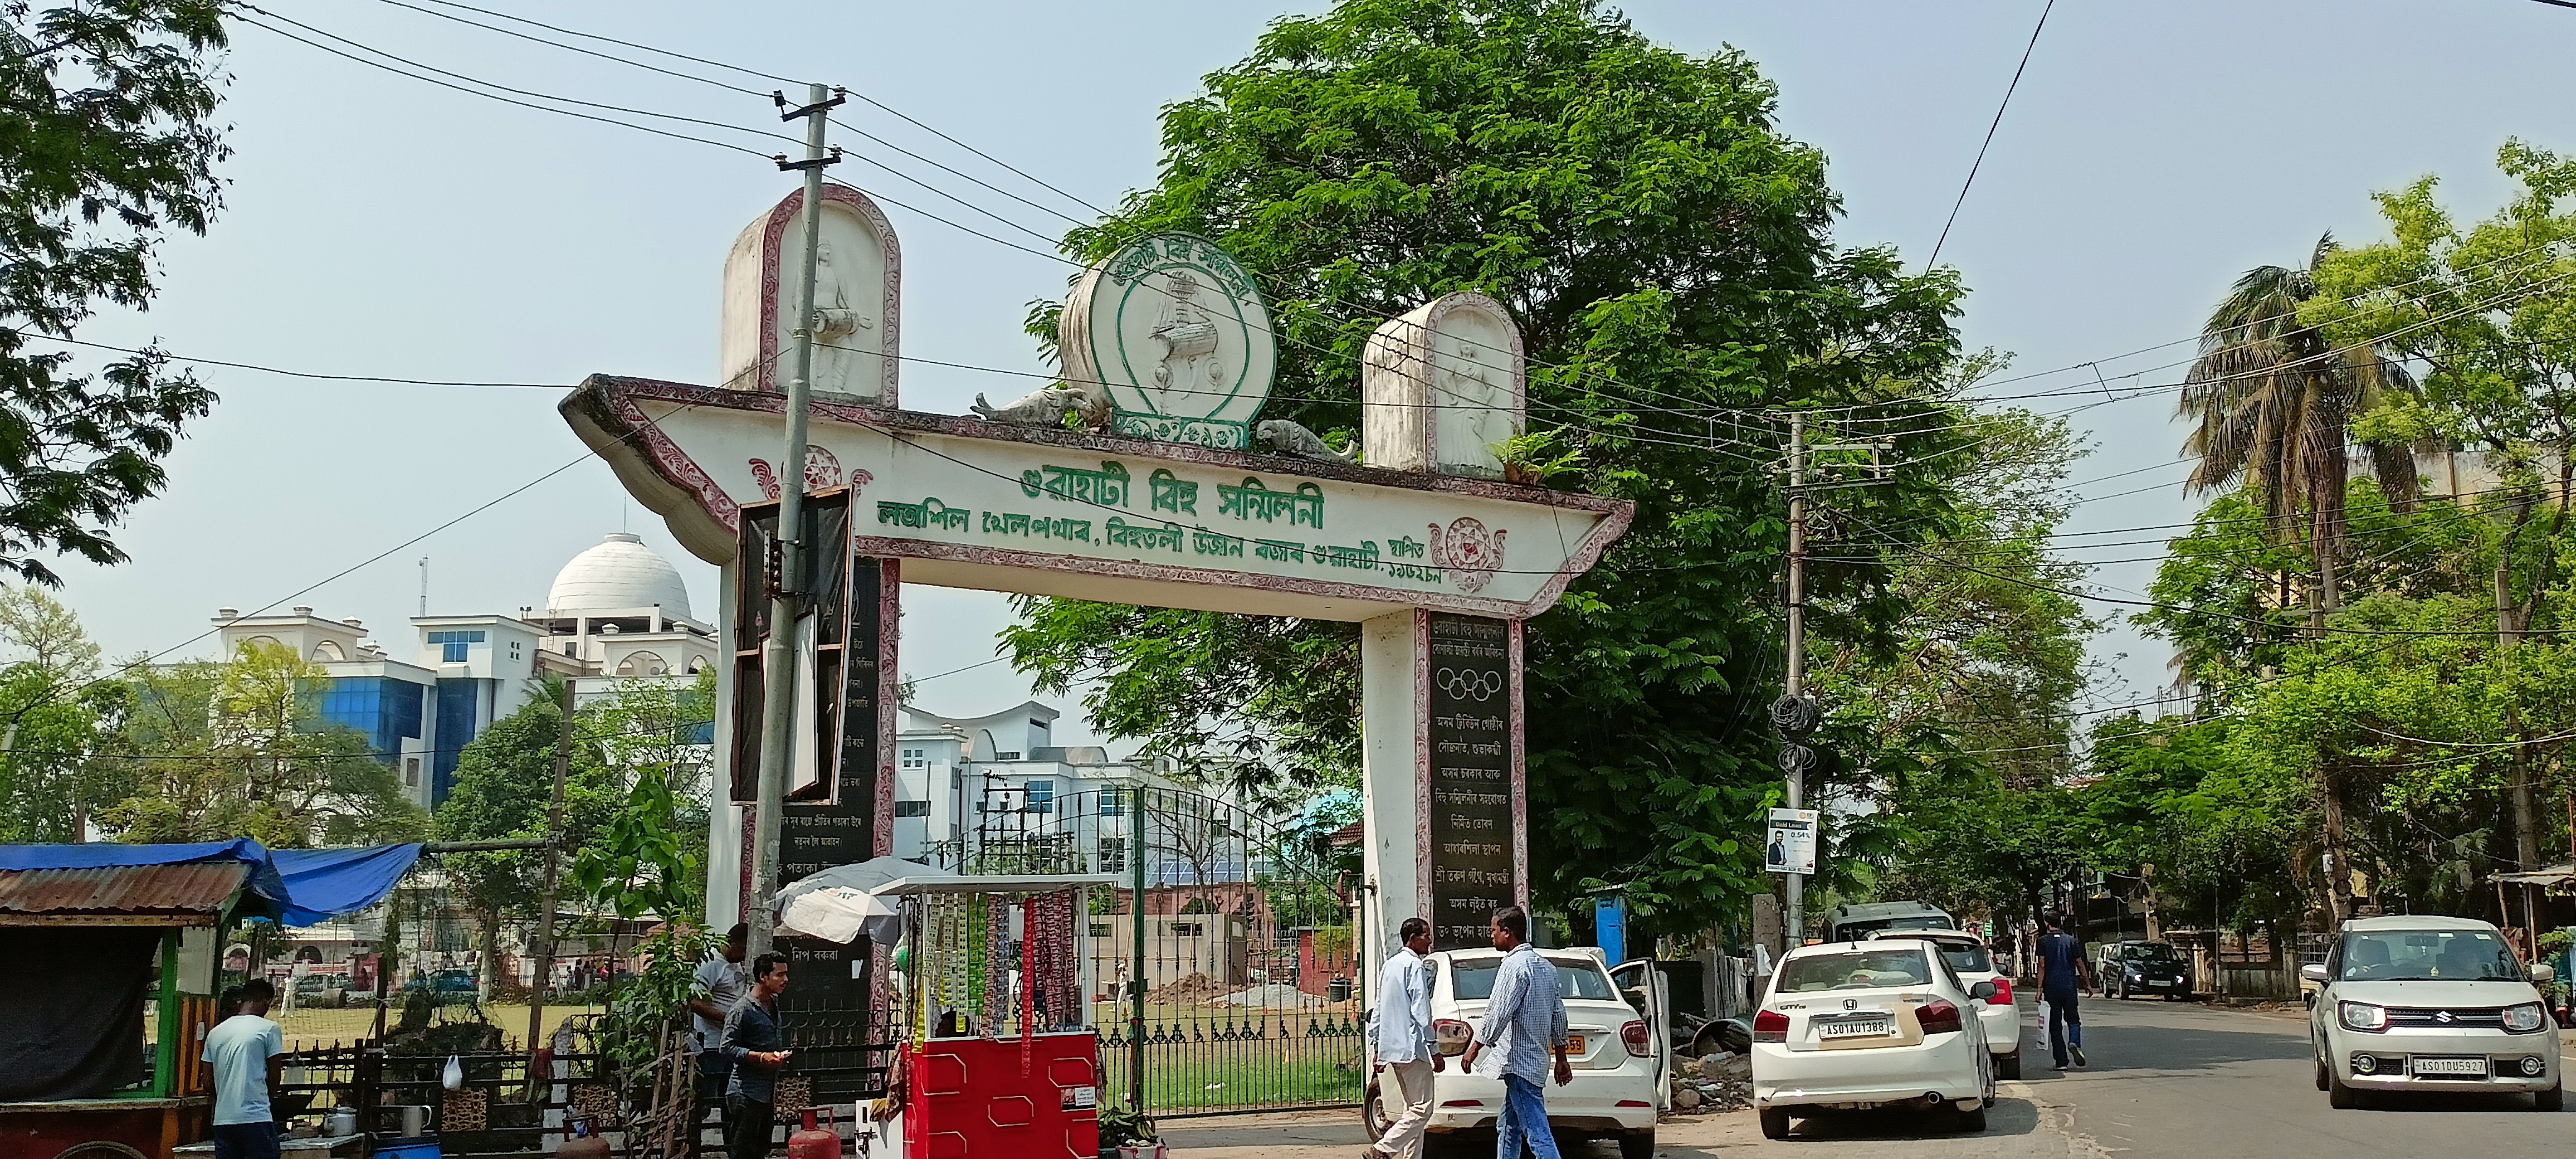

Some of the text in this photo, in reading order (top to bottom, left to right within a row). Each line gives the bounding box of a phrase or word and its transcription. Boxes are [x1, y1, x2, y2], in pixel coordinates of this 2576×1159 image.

[1149, 468, 1198, 517] বিহু
[1217, 476, 1325, 529] সন্মিলনী
[1435, 716, 1455, 729] অসম
[1441, 767, 1459, 778] অসম
[1460, 768, 1482, 780] চৰকাৰ
[1435, 787, 1447, 805] বিহু
[786, 862, 818, 875] পতাকা
[1435, 865, 1446, 883] শ্ৰী
[1448, 898, 1467, 909] অসম
[1827, 1021, 1885, 1035] AS01AU1388
[2422, 1061, 2483, 1072] AS01DU5927
